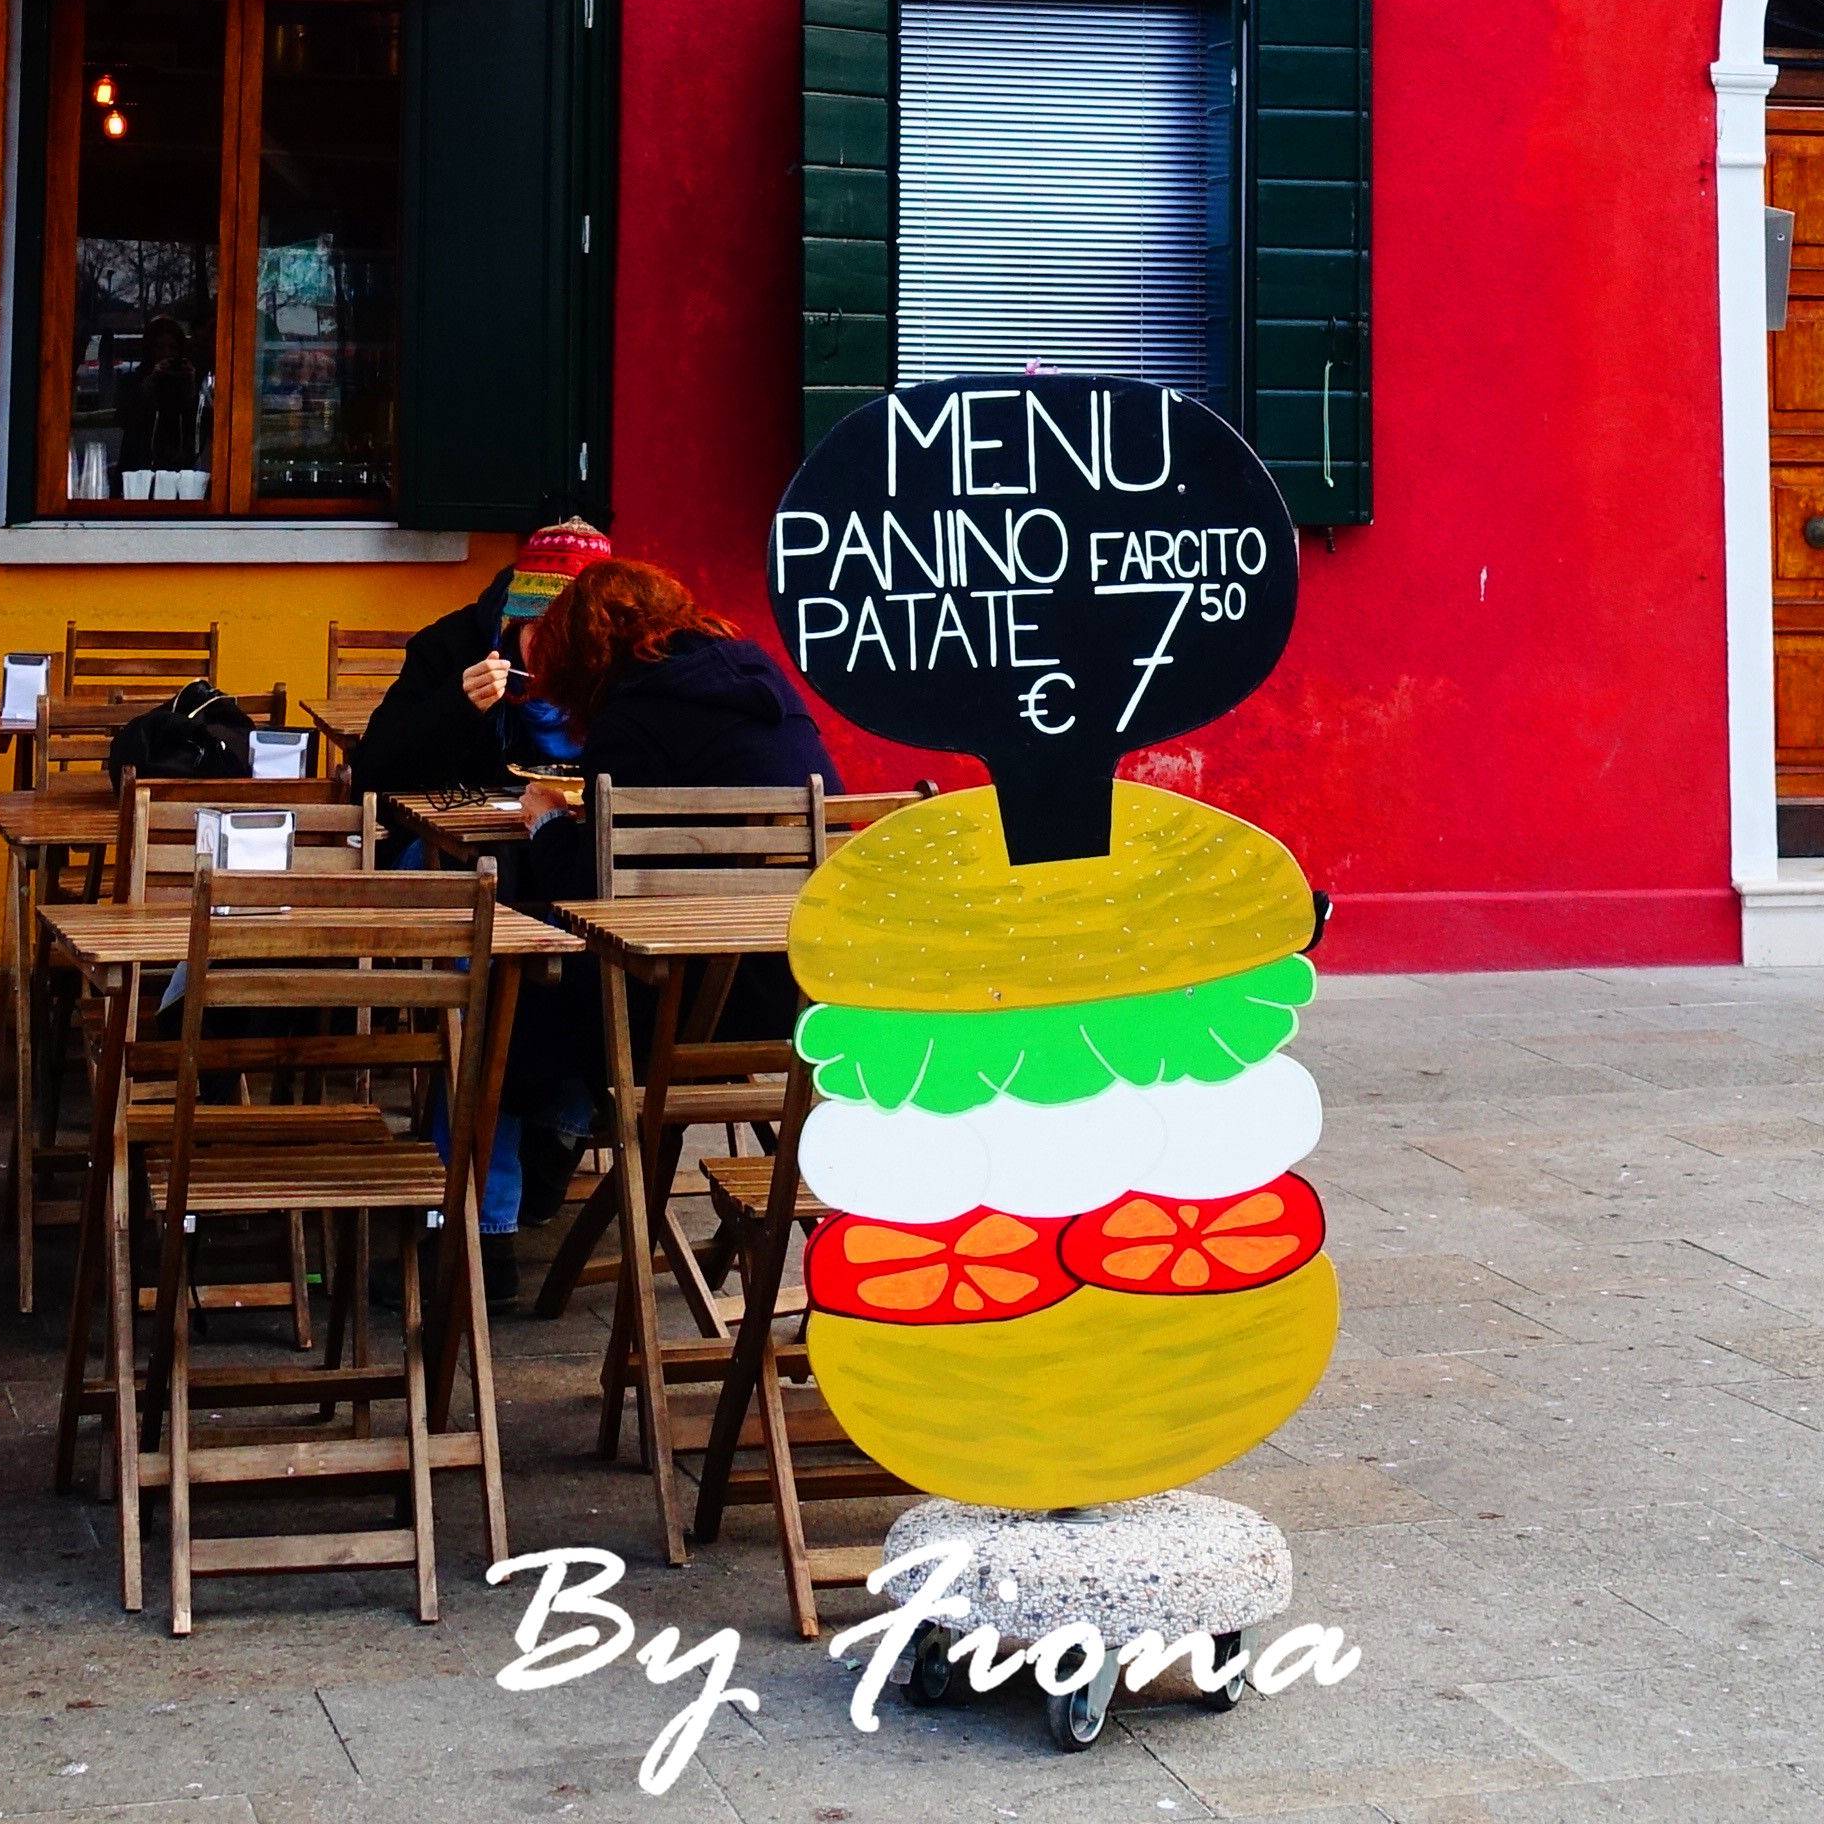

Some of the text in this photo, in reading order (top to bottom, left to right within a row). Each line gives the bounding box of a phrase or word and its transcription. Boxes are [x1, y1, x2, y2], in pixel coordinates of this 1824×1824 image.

[775, 508, 1268, 594] PANINO FARCITO
[797, 587, 1061, 673] PATATE
